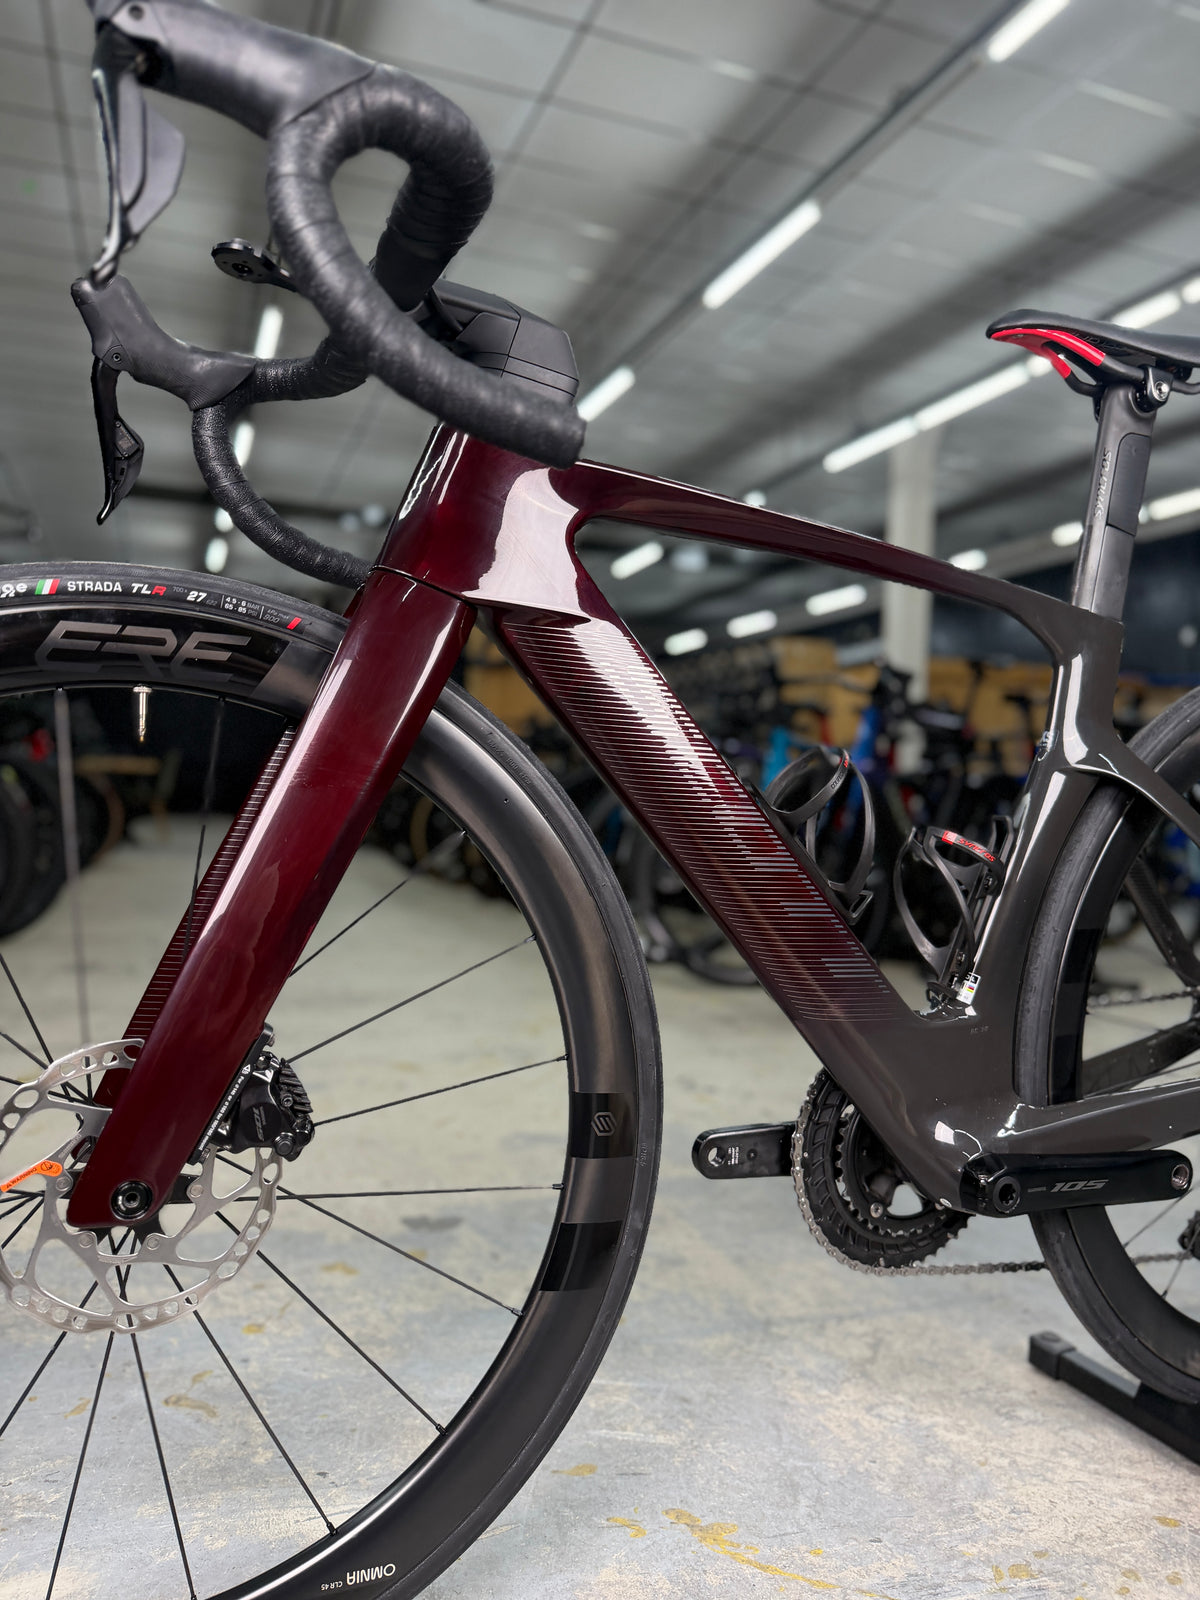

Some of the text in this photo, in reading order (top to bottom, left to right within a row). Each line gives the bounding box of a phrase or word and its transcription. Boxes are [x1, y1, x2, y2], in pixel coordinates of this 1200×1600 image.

[67, 581, 123, 592] STRADA
[131, 583, 167, 596] TLR
[186, 590, 208, 602] 27
[35, 620, 252, 683] ERE
[1050, 1179, 1110, 1193] 105
[320, 1563, 396, 1591] OMNIA CLR 45
